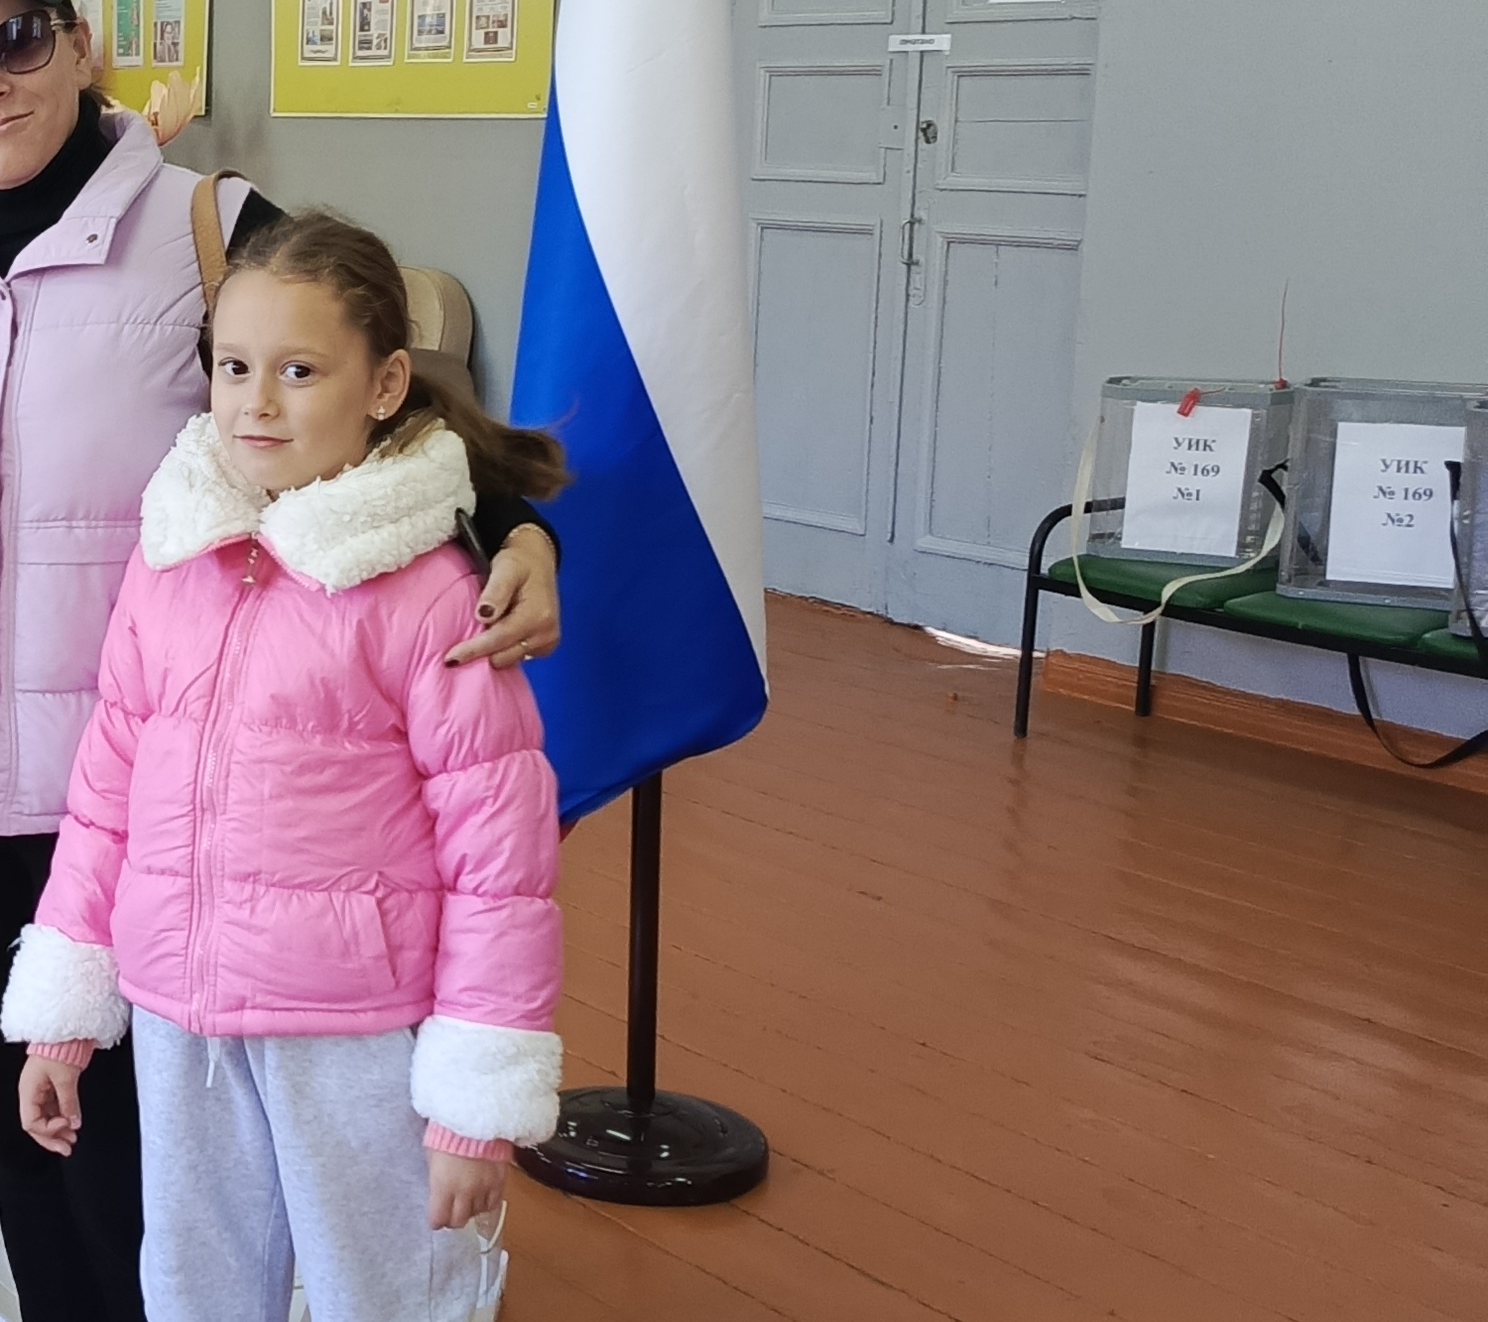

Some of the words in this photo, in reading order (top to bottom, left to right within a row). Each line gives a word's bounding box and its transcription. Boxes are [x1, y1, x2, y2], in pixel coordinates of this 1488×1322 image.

[1173, 437, 1217, 452] УИК
[1165, 461, 1186, 475] №
[1193, 463, 1220, 477] 169
[1380, 458, 1428, 474] УИК
[1172, 487, 1200, 501] №1
[1373, 485, 1395, 499] №
[1402, 486, 1433, 501] 169
[1381, 512, 1414, 527] №2
